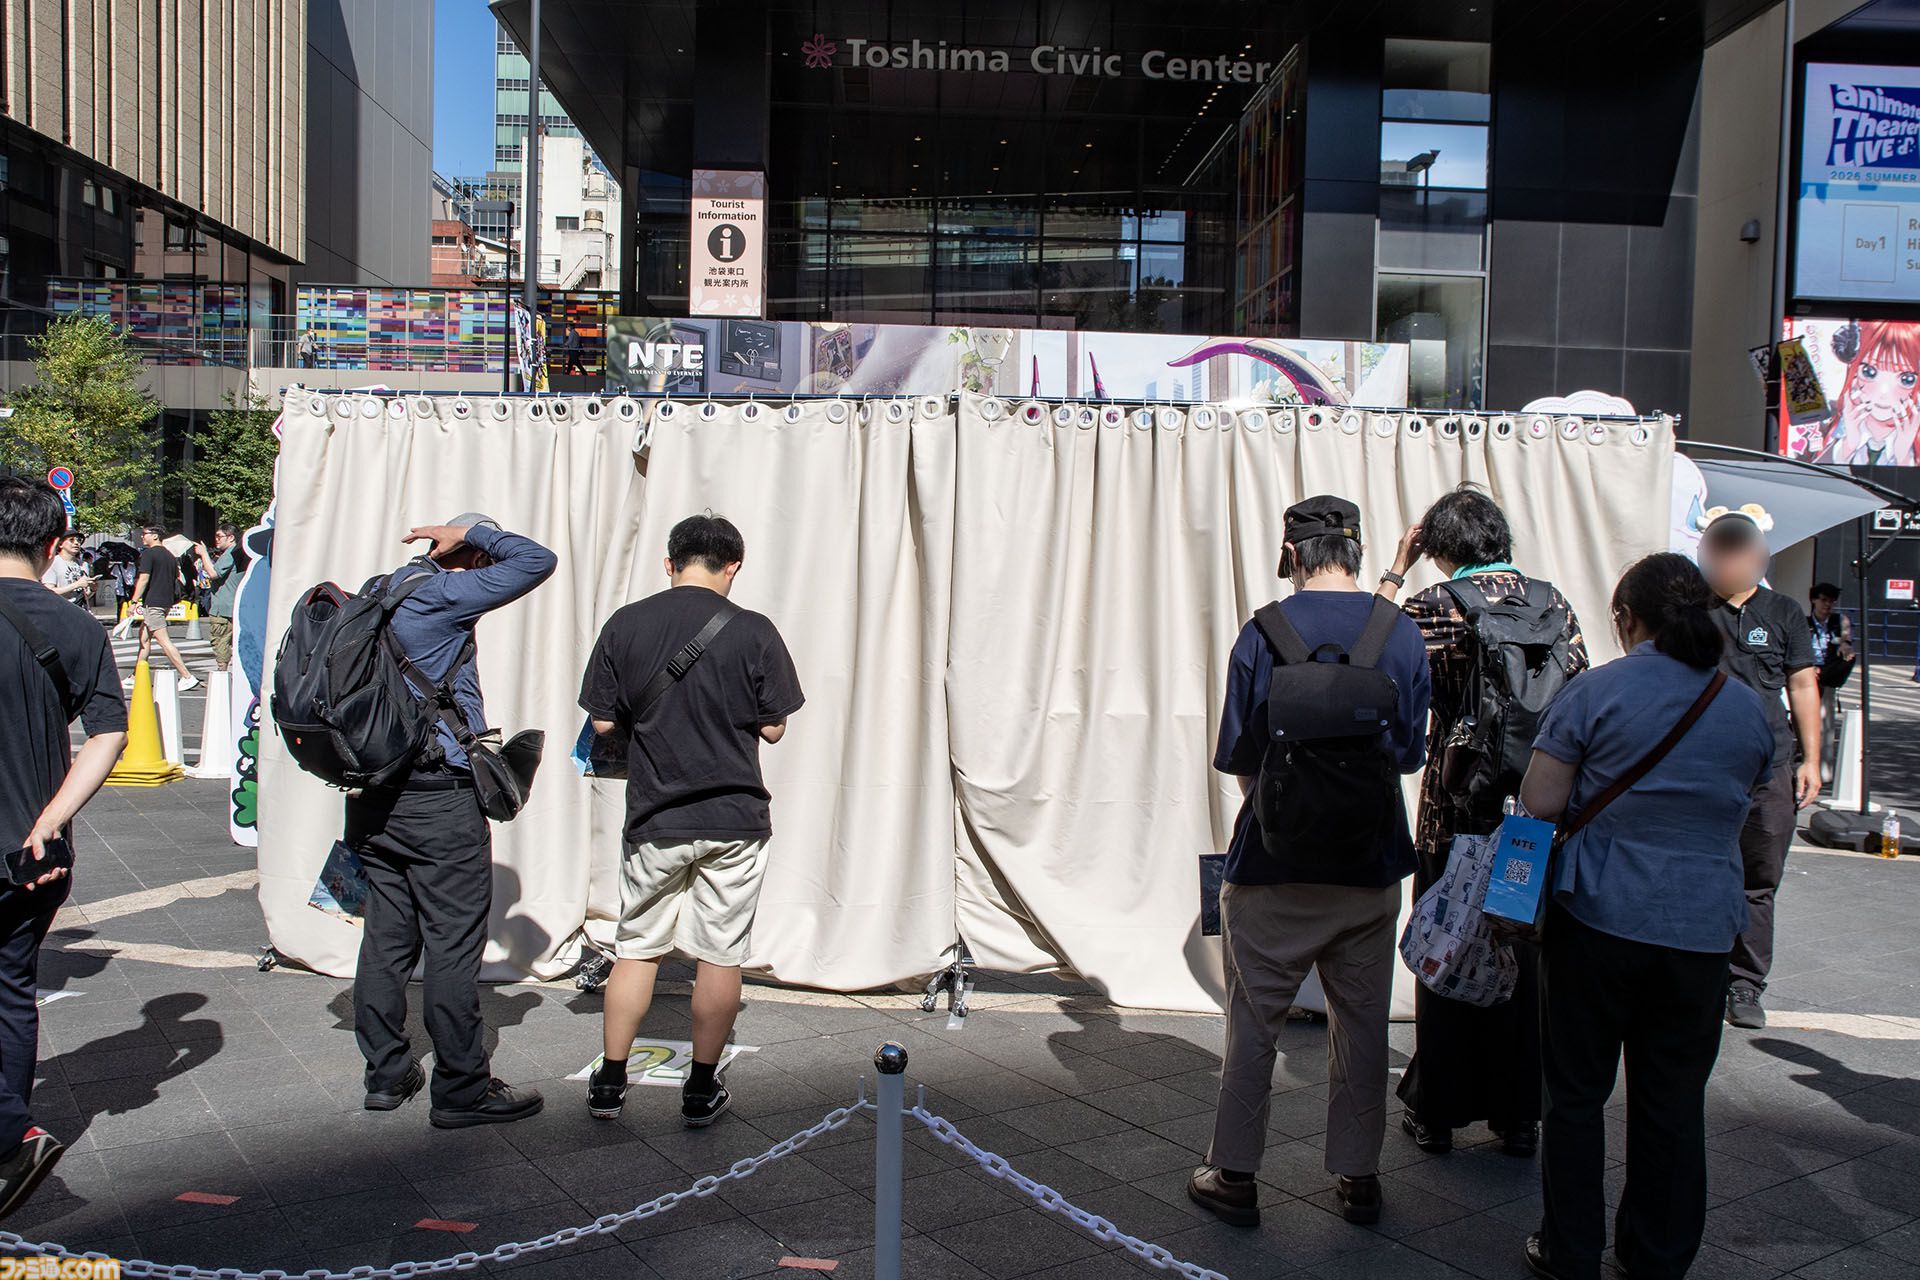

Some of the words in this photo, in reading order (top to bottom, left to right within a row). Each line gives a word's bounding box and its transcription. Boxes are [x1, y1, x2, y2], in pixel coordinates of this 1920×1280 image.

[846, 38, 1009, 72] Toshima
[1031, 45, 1122, 77] Civic
[1141, 50, 1271, 83] Center
[1833, 139, 1895, 167] LIVE
[1865, 172, 1918, 182] SUMMER
[710, 200, 745, 209] Tourist
[698, 211, 757, 221] Information
[1908, 218, 1920, 230] R
[708, 267, 745, 276] 池袋東口
[704, 279, 749, 288] 観光案内所
[628, 342, 704, 369] NTE
[1511, 837, 1538, 851] NTE
